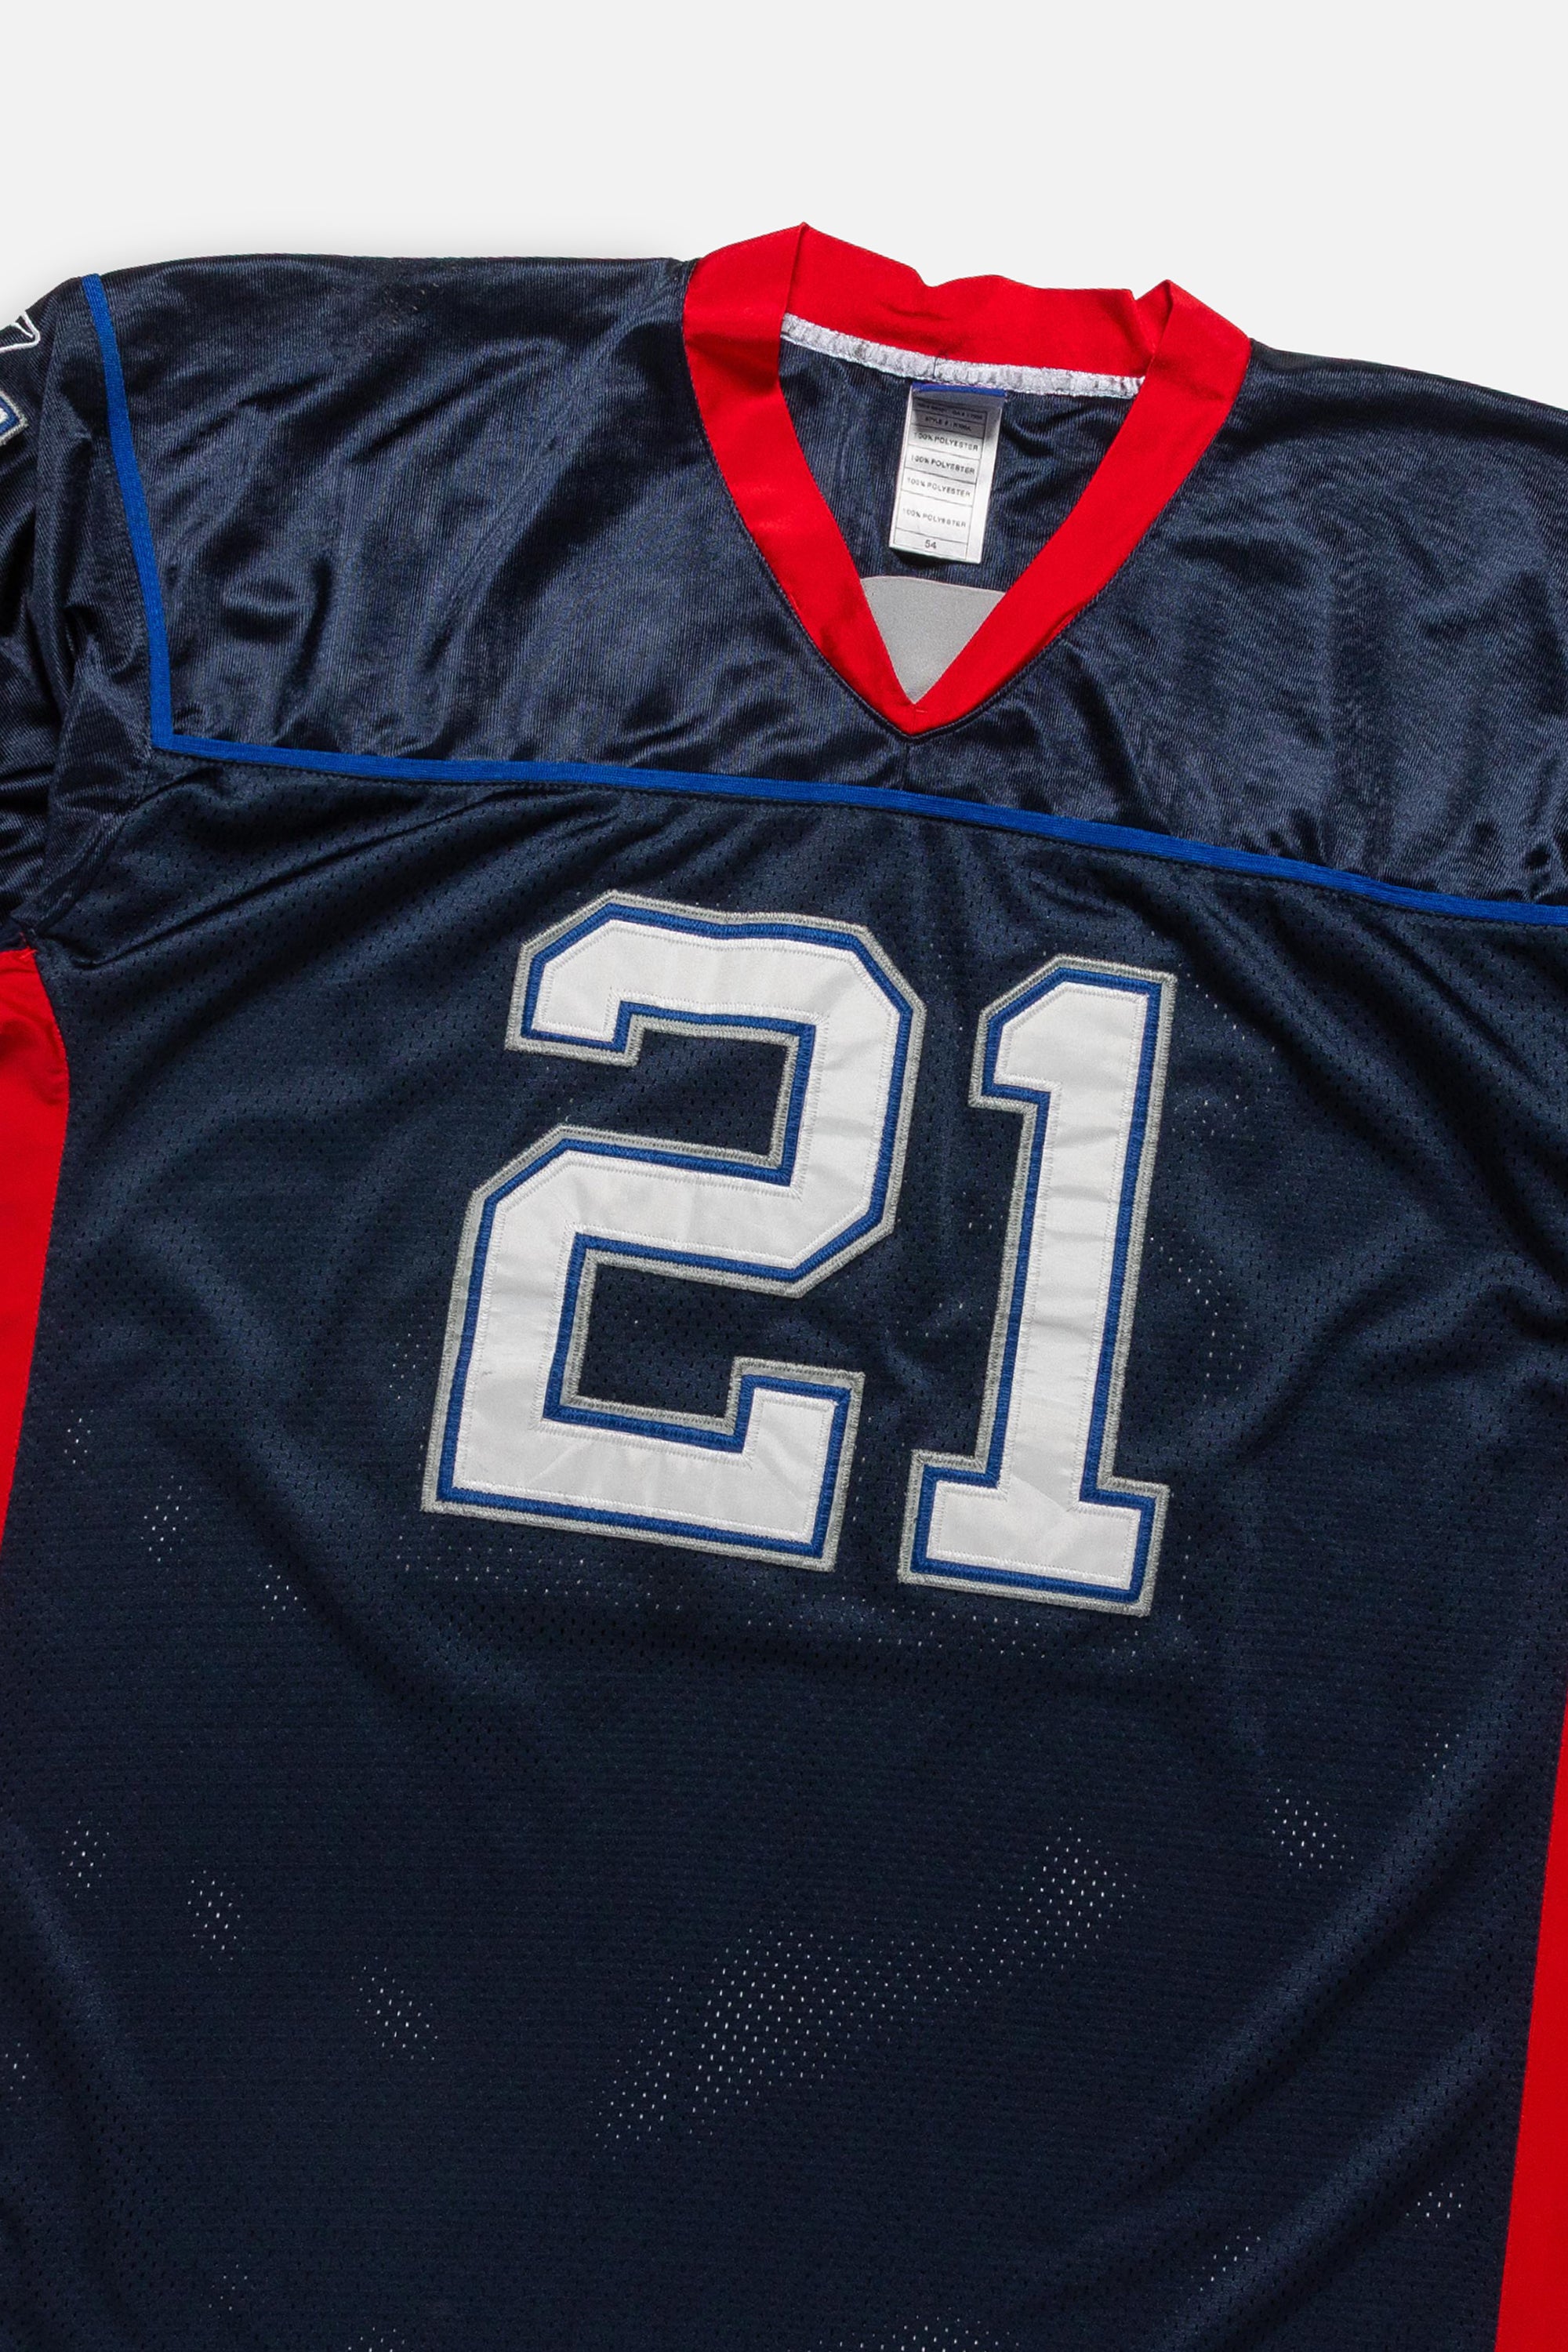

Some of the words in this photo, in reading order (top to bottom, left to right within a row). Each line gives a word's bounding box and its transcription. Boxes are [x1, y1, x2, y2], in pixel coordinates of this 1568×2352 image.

[914, 433, 933, 441] 100%
[935, 436, 978, 452] POLYESTER
[911, 455, 929, 464] 100%
[931, 459, 975, 475] POLYESTER
[907, 477, 926, 487] 100%
[927, 482, 971, 497] POLYESTER
[902, 508, 920, 517] 100%
[923, 513, 966, 528] POLYESTER
[925, 539, 937, 549] 54
[421, 891, 1176, 1617] 21
